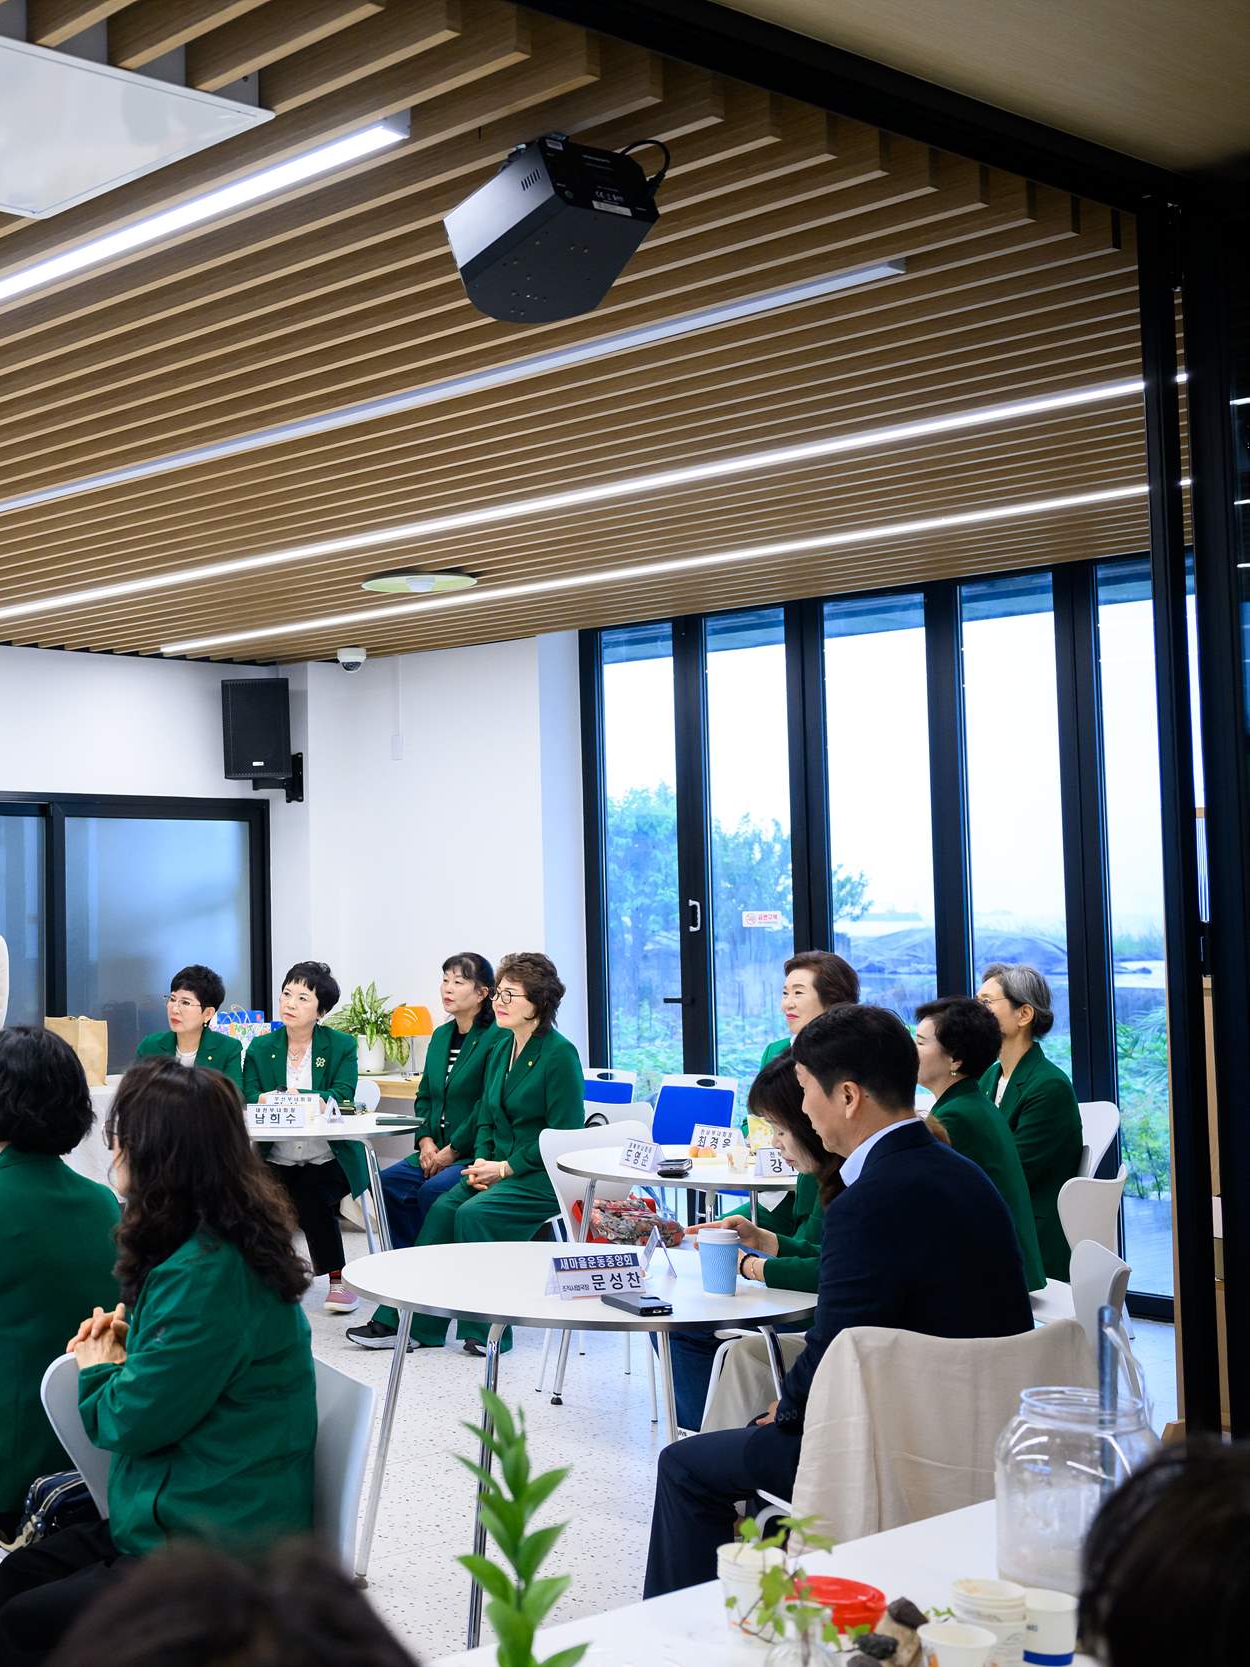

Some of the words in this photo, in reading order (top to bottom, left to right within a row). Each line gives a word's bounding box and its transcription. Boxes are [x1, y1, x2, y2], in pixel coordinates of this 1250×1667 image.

[255, 1113, 296, 1124] 남희수
[559, 1254, 633, 1270] 새마을운동중앙회
[591, 1271, 642, 1291] 문성찬
